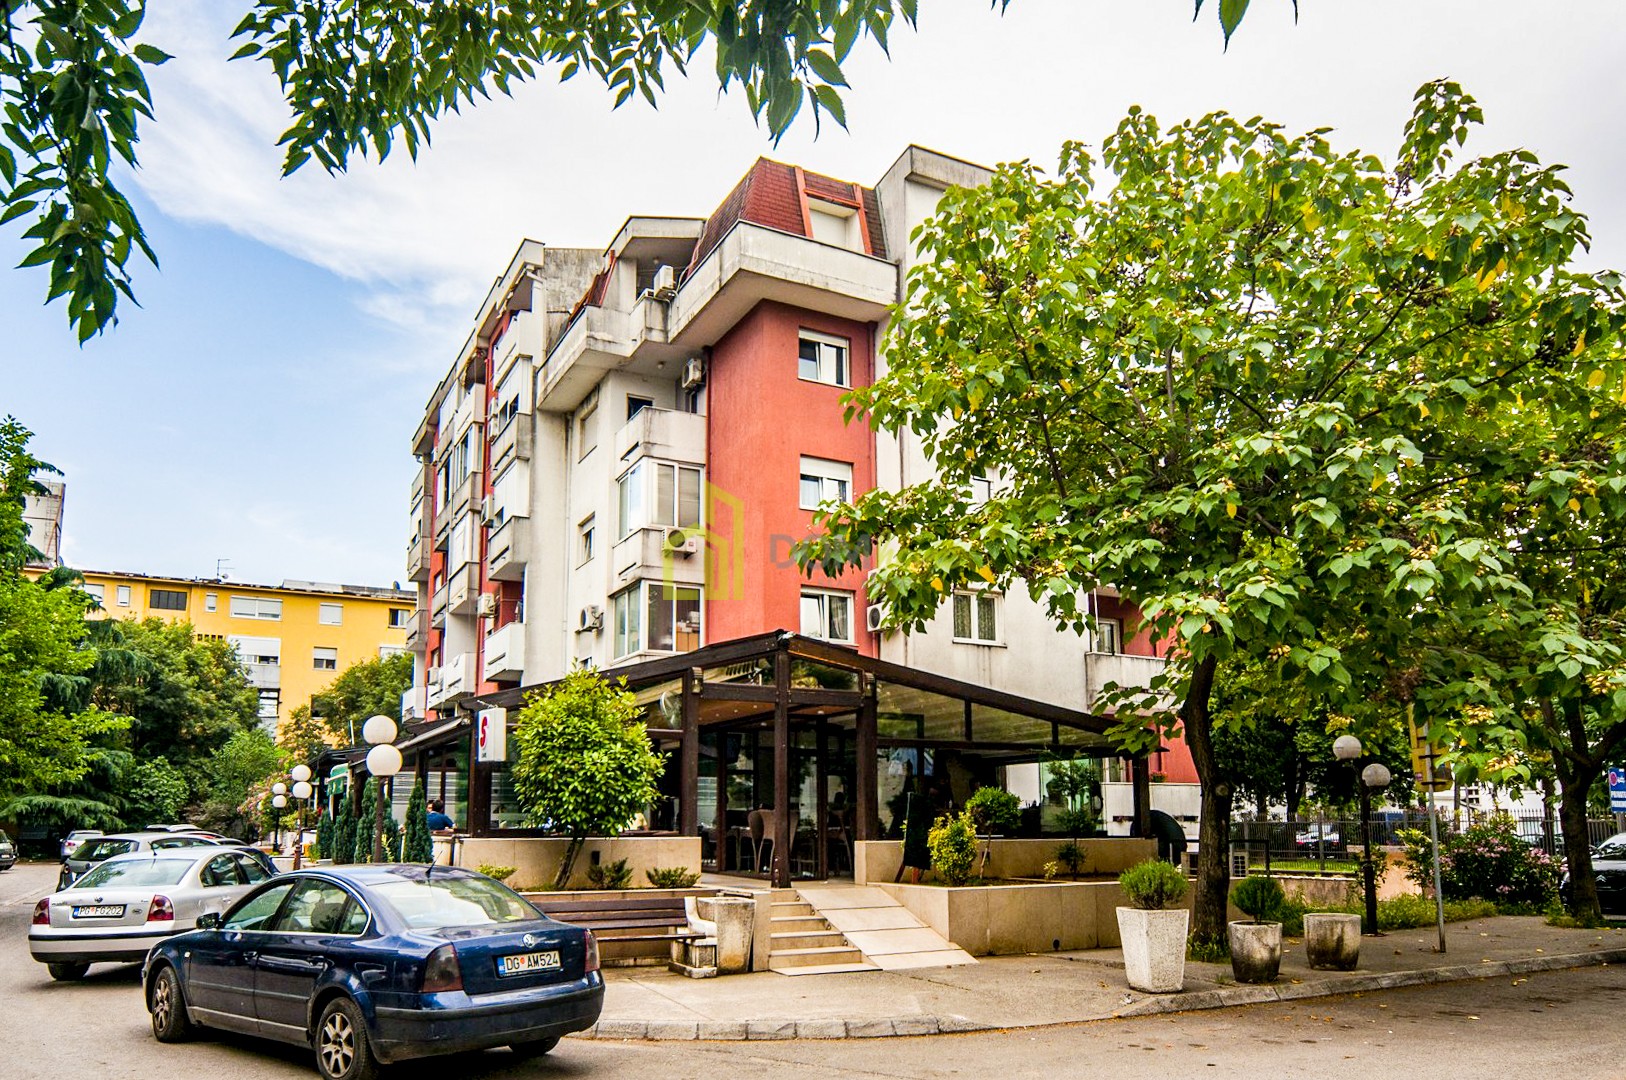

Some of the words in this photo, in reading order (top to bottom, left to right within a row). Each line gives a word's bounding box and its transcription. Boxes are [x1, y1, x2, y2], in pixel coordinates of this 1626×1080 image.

[79, 906, 90, 915] PG
[95, 906, 122, 915] FG202
[505, 957, 520, 971] DG
[527, 953, 559, 969] AM524
